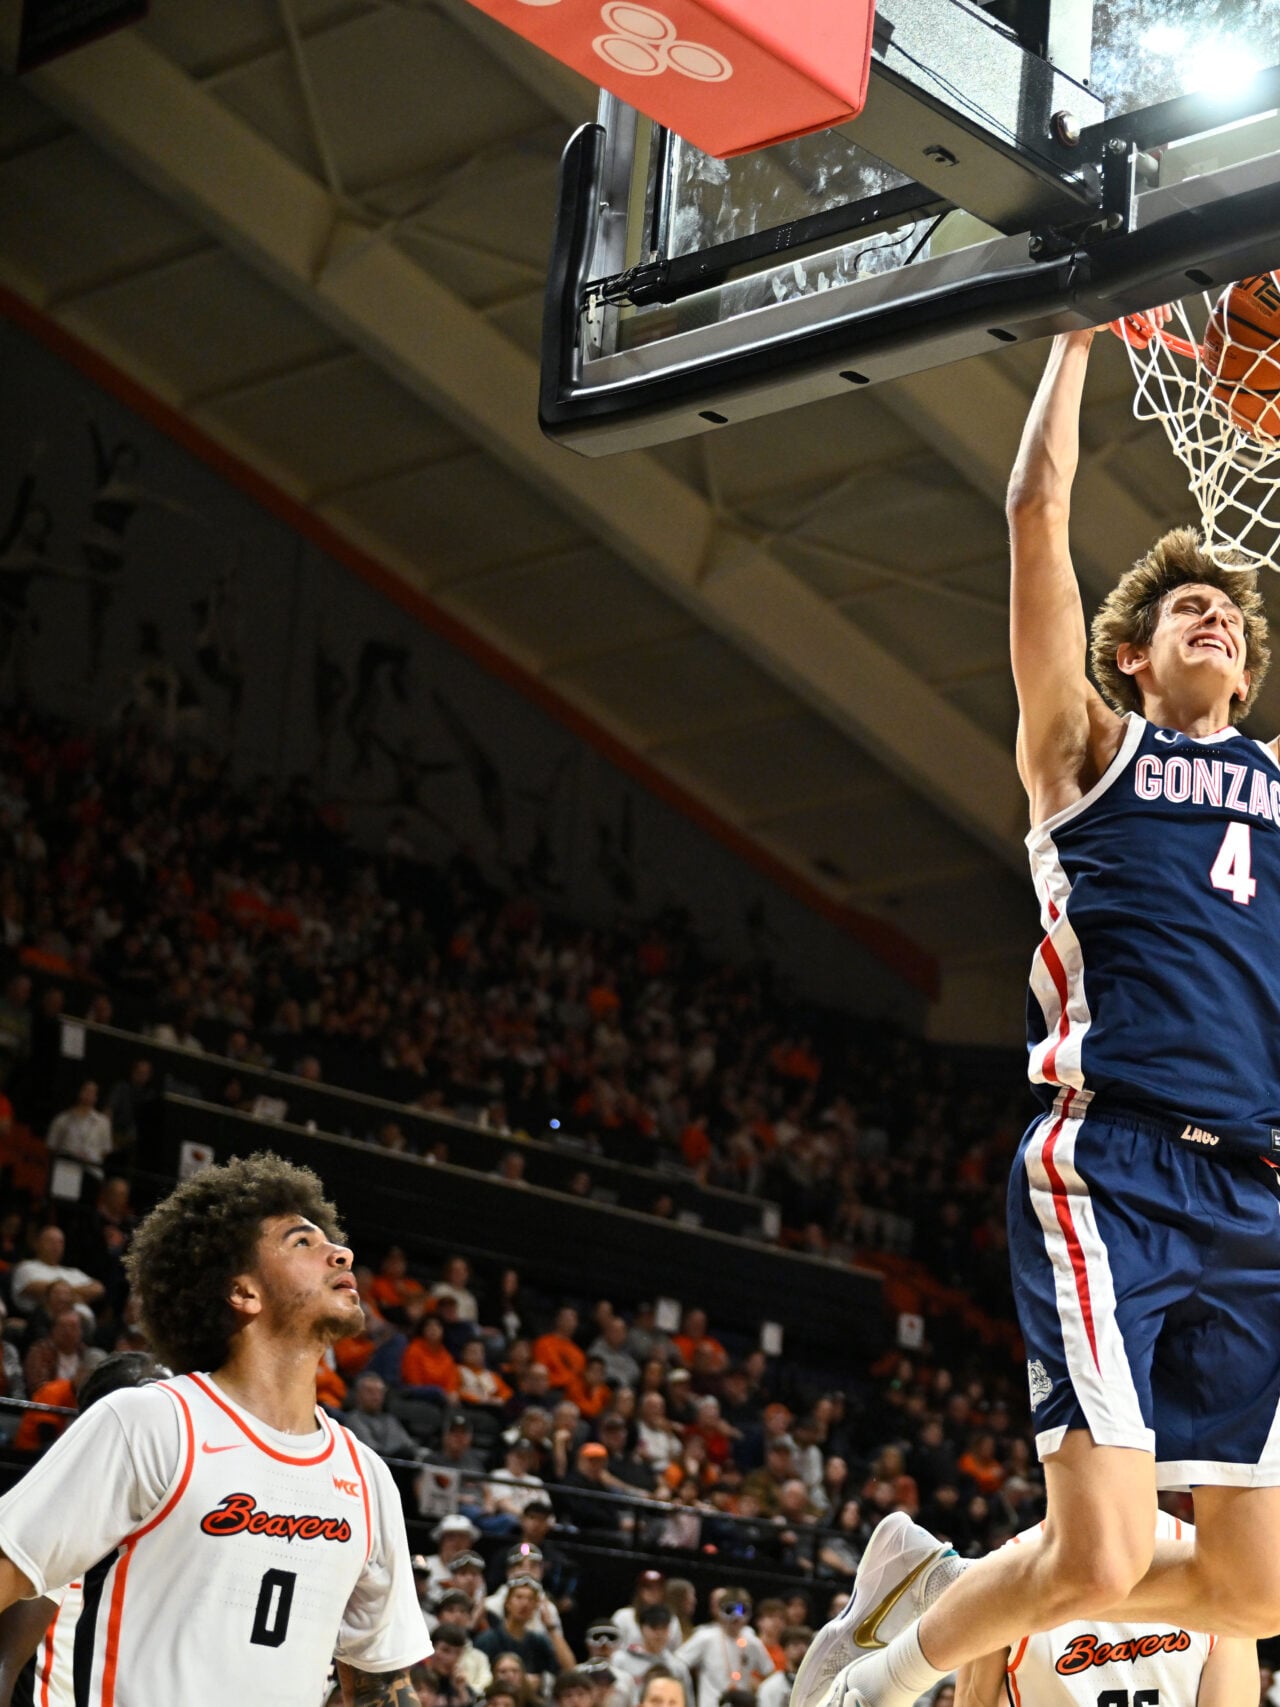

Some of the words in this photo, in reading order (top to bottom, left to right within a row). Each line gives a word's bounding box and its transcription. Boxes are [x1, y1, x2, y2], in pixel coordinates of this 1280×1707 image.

[1209, 821, 1257, 906] 4
[332, 1474, 361, 1498] WCC
[200, 1492, 352, 1544] Beavers
[250, 1567, 298, 1648] 0
[1055, 1629, 1191, 1676] Beavers
